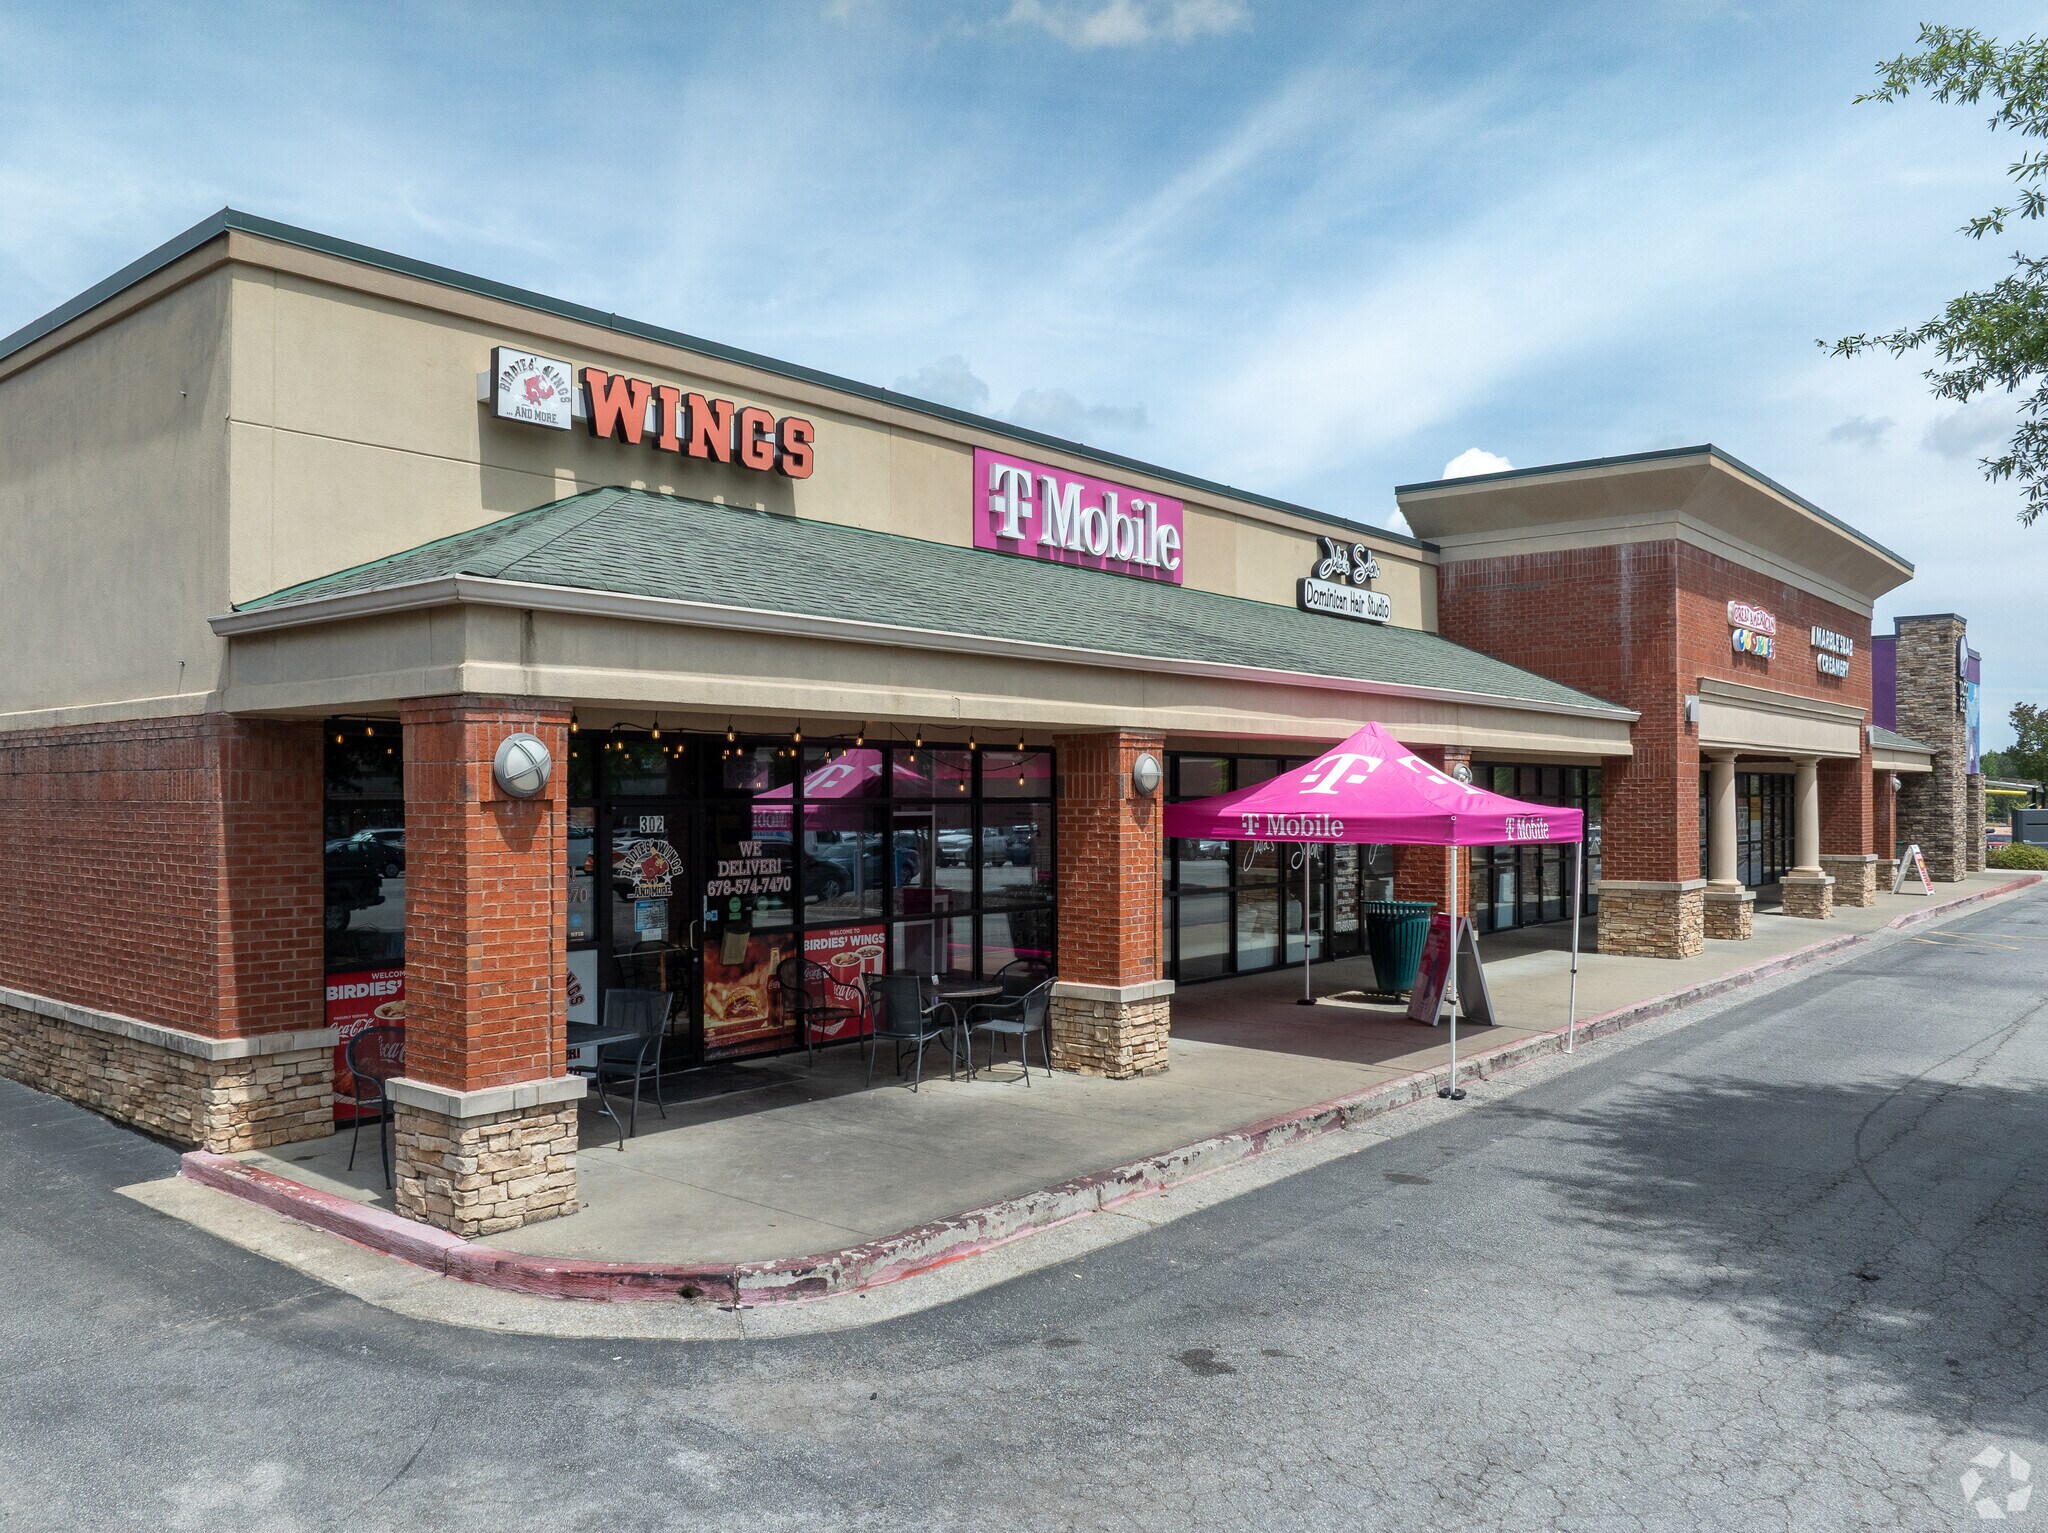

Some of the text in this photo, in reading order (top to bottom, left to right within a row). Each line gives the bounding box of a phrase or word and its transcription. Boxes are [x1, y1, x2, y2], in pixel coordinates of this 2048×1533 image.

[542, 365, 571, 403] WINGS
[579, 367, 815, 479] WINGS
[989, 463, 1181, 571] T Mobile
[1306, 580, 1389, 619] Dominican Hair Studio
[1738, 629, 1776, 660] COOKIES
[640, 816, 664, 833] 302
[1242, 813, 1344, 838] T Mobile
[1505, 817, 1549, 840] T Mobile
[620, 838, 655, 878] BIRDIES'
[656, 840, 684, 875] WINGS
[738, 841, 762, 857] WE
[717, 858, 782, 877] DELIVER!
[707, 876, 792, 896] 678-574-7470
[804, 933, 885, 951] BIRDIES' WINGS
[371, 970, 406, 980] WELCOM
[325, 980, 402, 1001] BIRDIES'
